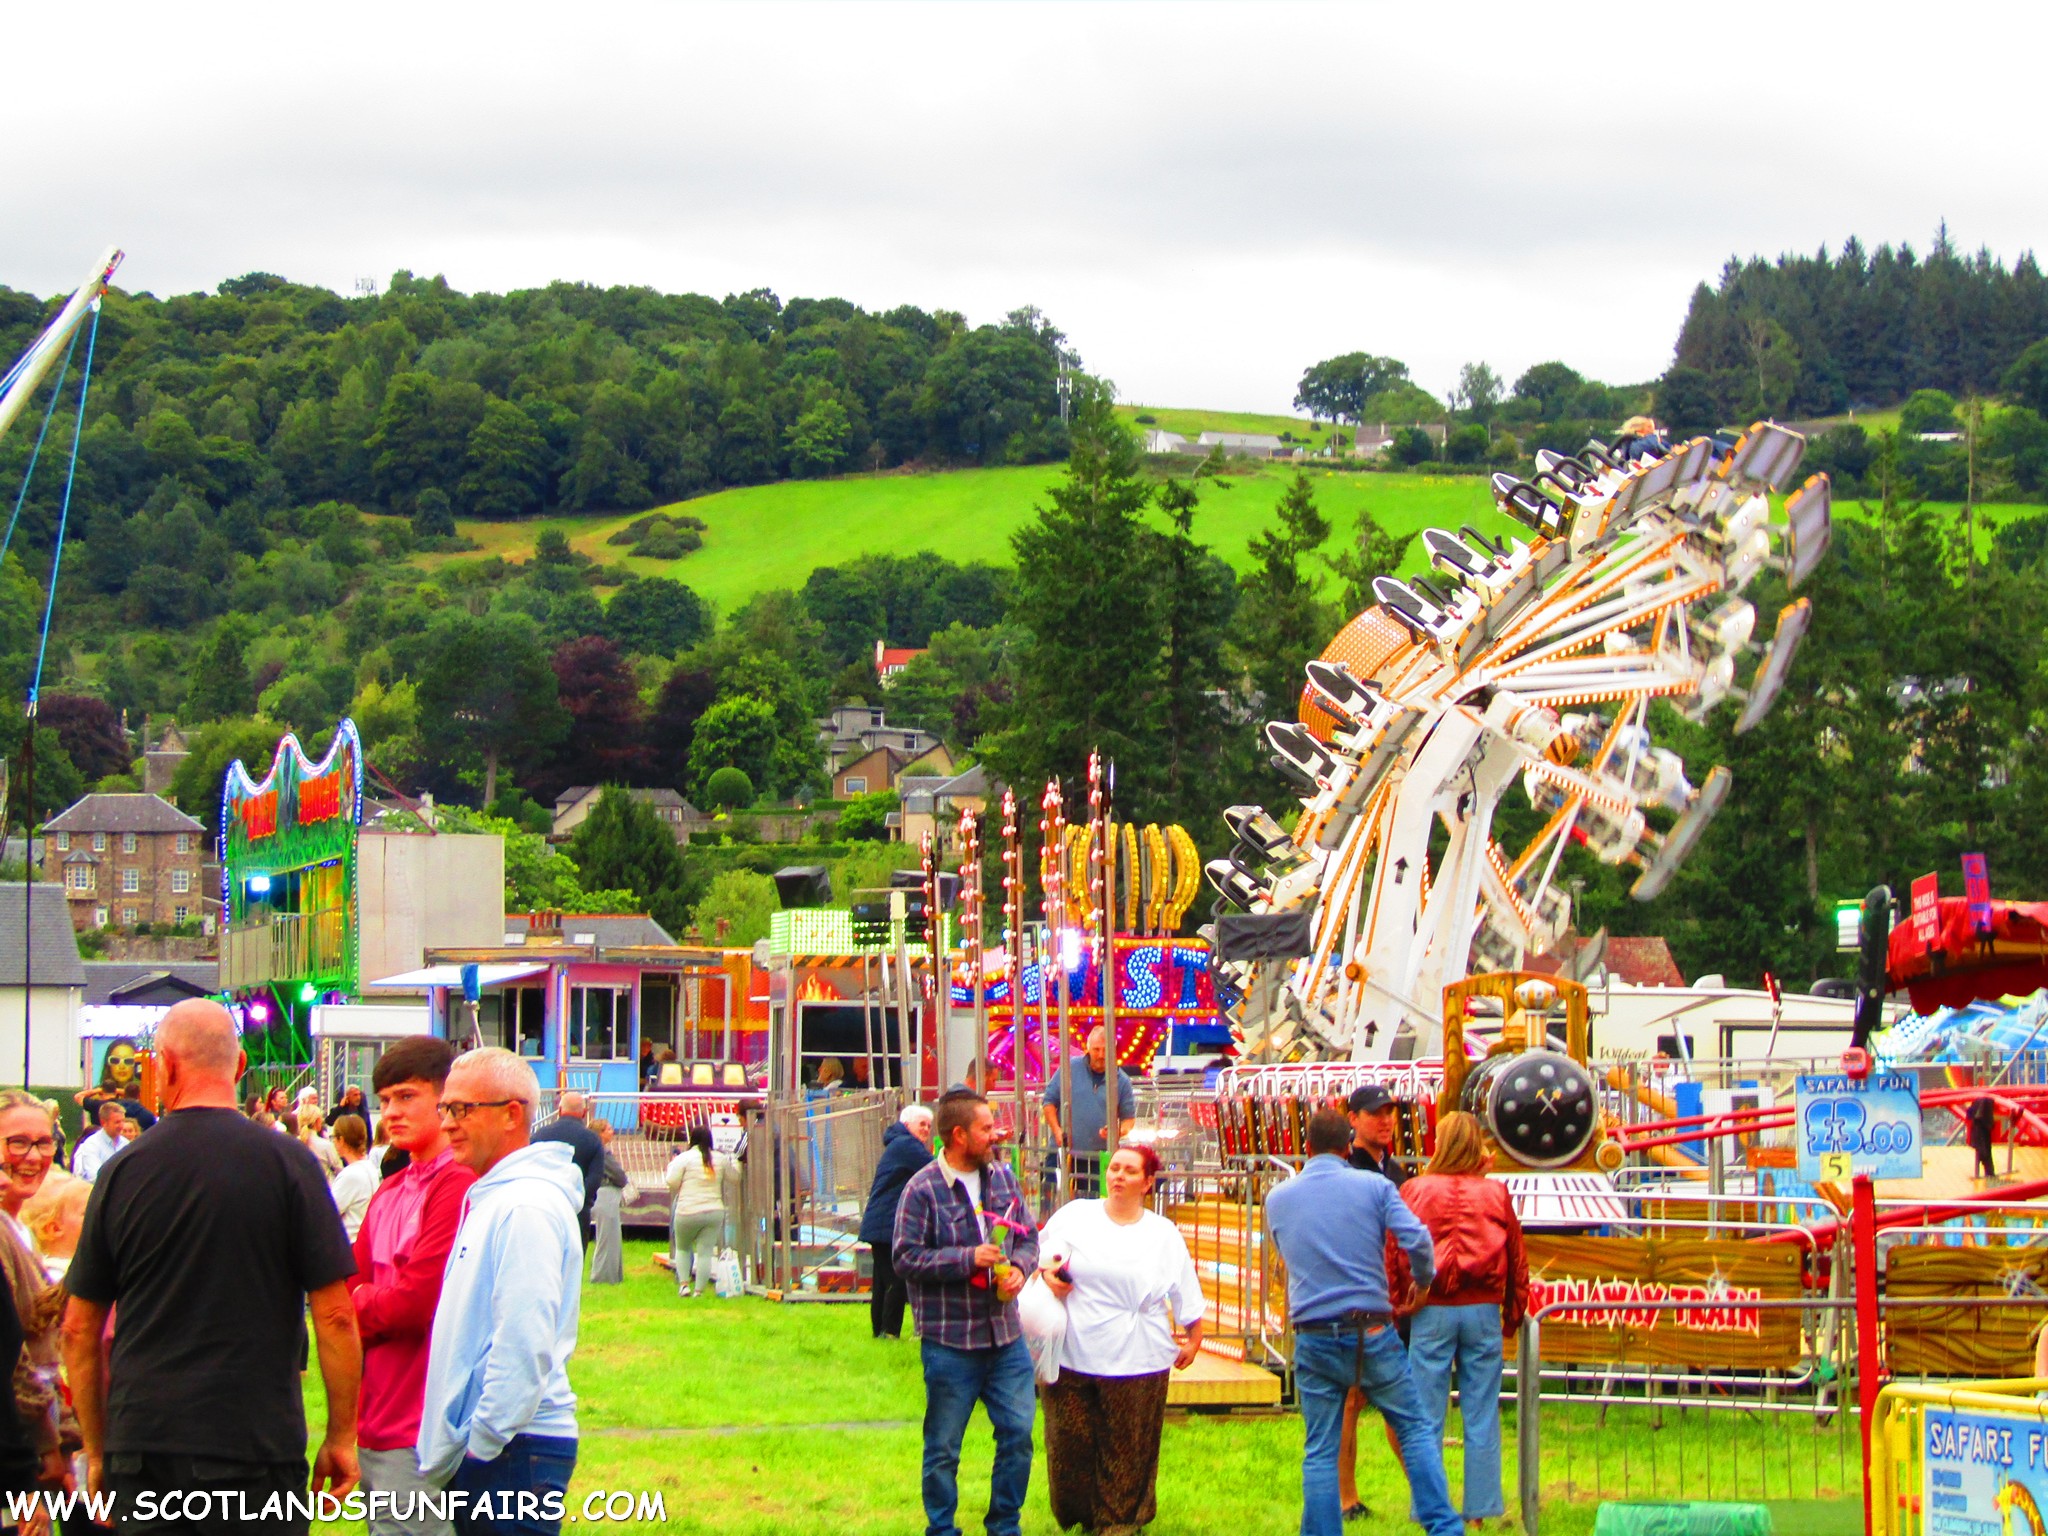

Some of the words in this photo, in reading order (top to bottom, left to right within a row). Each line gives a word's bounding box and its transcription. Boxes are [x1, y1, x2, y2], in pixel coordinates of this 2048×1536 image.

[1599, 1046, 1647, 1060] Wildcat
[1805, 1079, 1868, 1093] SAFARI
[1879, 1077, 1910, 1091] FUN
[1805, 1097, 1912, 1156] £3.00
[1828, 1156, 1843, 1177] 5
[1529, 1274, 1667, 1331] RUNAWAY
[1669, 1279, 1761, 1338] TRAIN
[1930, 1421, 2013, 1466] SAFARI
